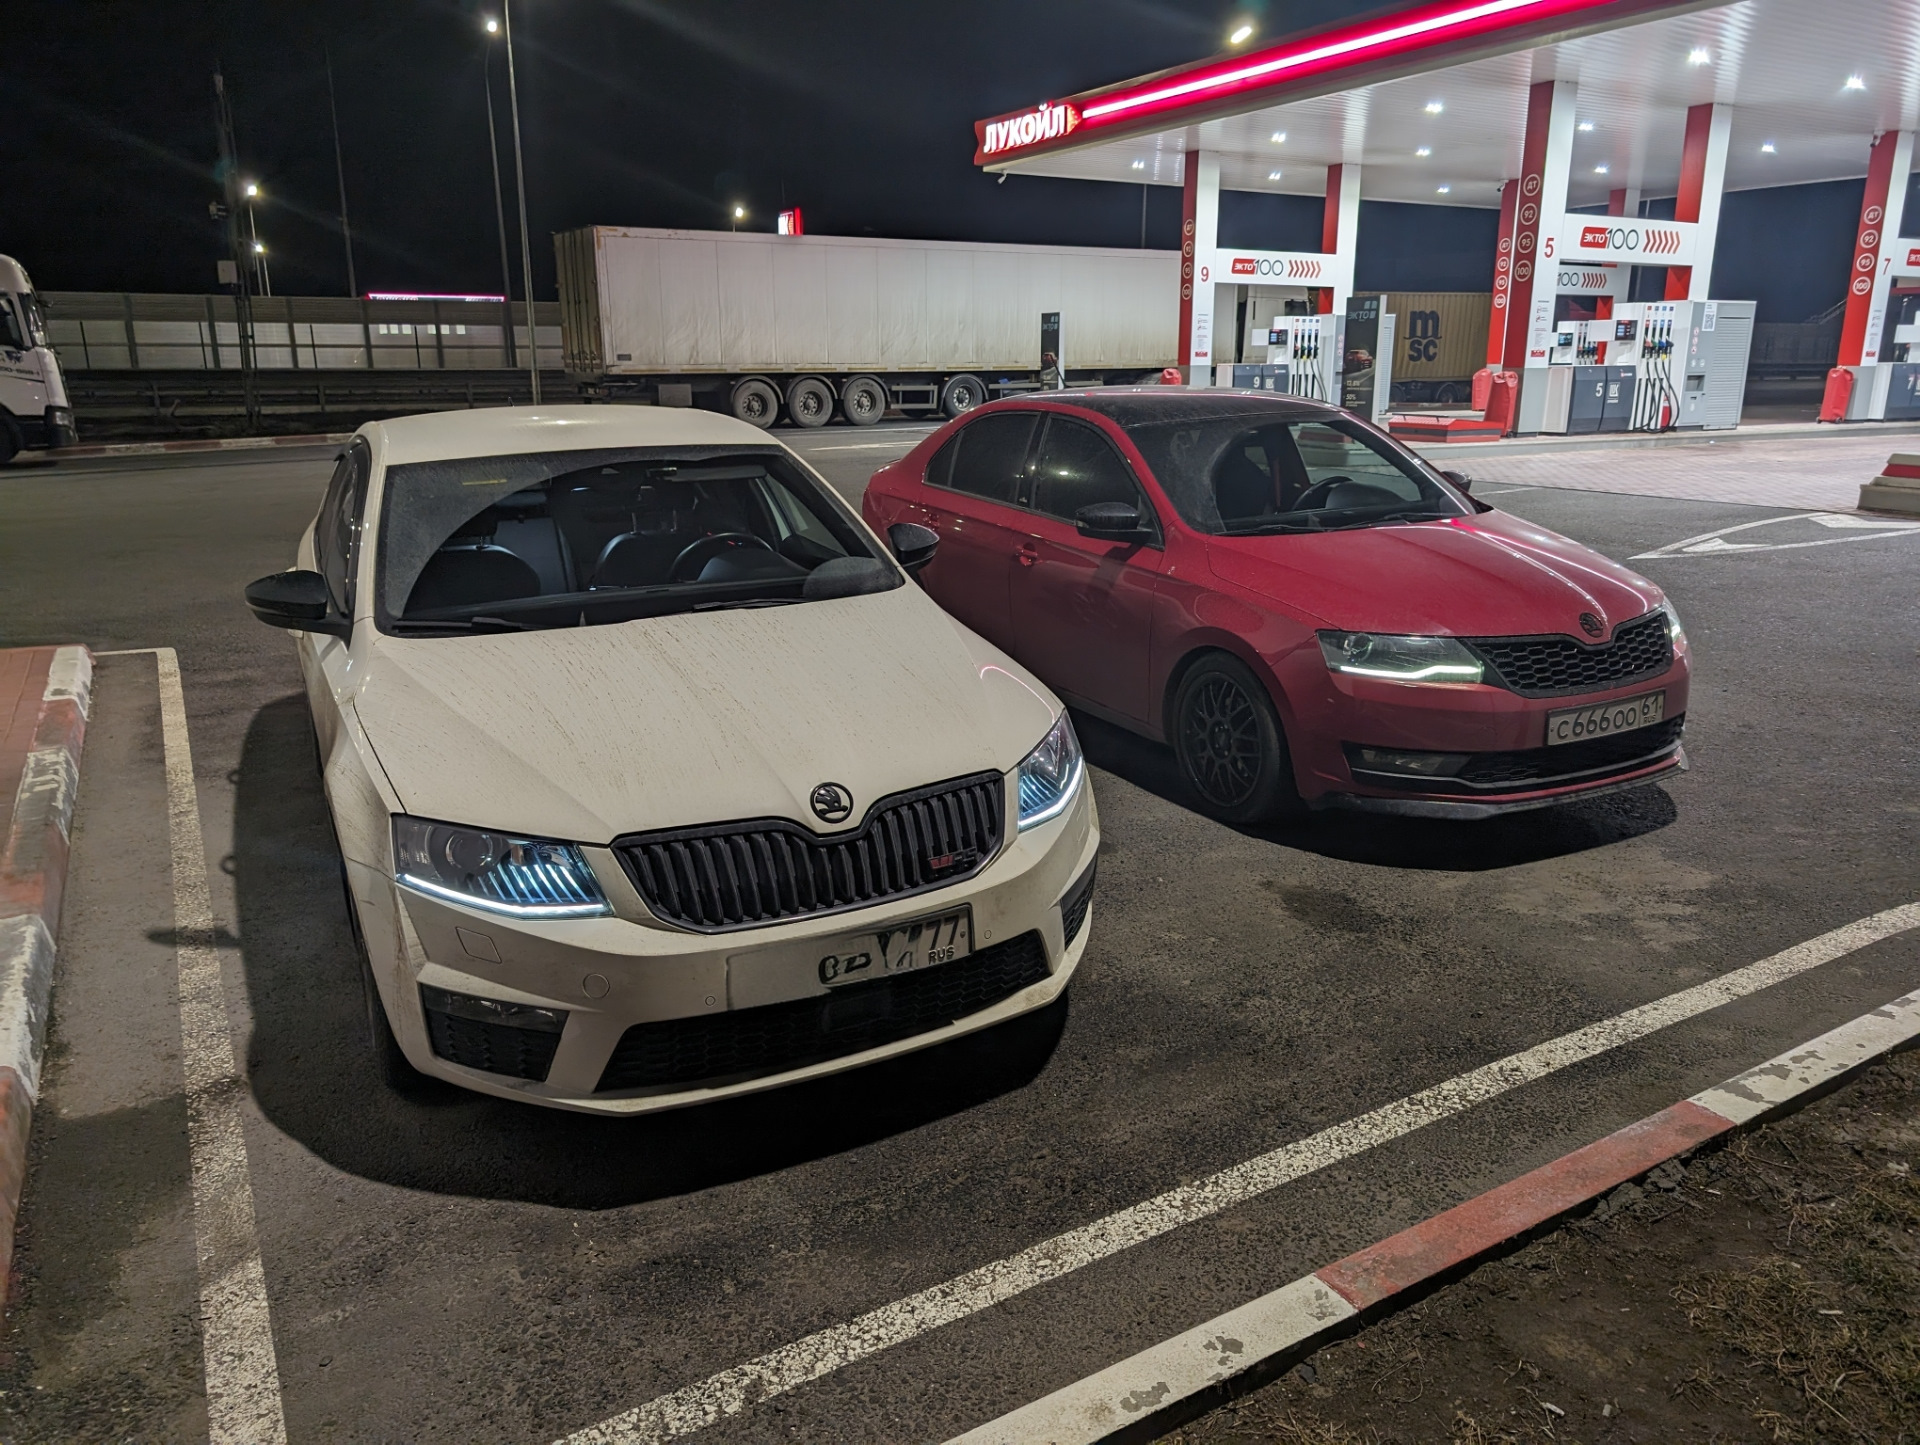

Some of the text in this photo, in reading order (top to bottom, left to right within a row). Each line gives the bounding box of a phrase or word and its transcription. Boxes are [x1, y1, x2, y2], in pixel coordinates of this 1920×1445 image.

[983, 103, 1065, 153] ЛУКОЙЛ
[1524, 209, 1534, 218] 92
[1521, 238, 1531, 247] 95
[1583, 228, 1640, 251] ЭКТО 100
[1864, 235, 1874, 243] 92
[1544, 237, 1555, 259] 5
[1234, 258, 1284, 276] ЭКТО 100
[1517, 266, 1529, 275] 100
[1883, 257, 1892, 275] 7
[1200, 266, 1209, 282] 9
[1253, 376, 1260, 388] 9
[1595, 382, 1604, 397] 5
[1907, 376, 1915, 391] 7
[1643, 714, 1657, 724] RUS
[928, 946, 955, 965] RUS
